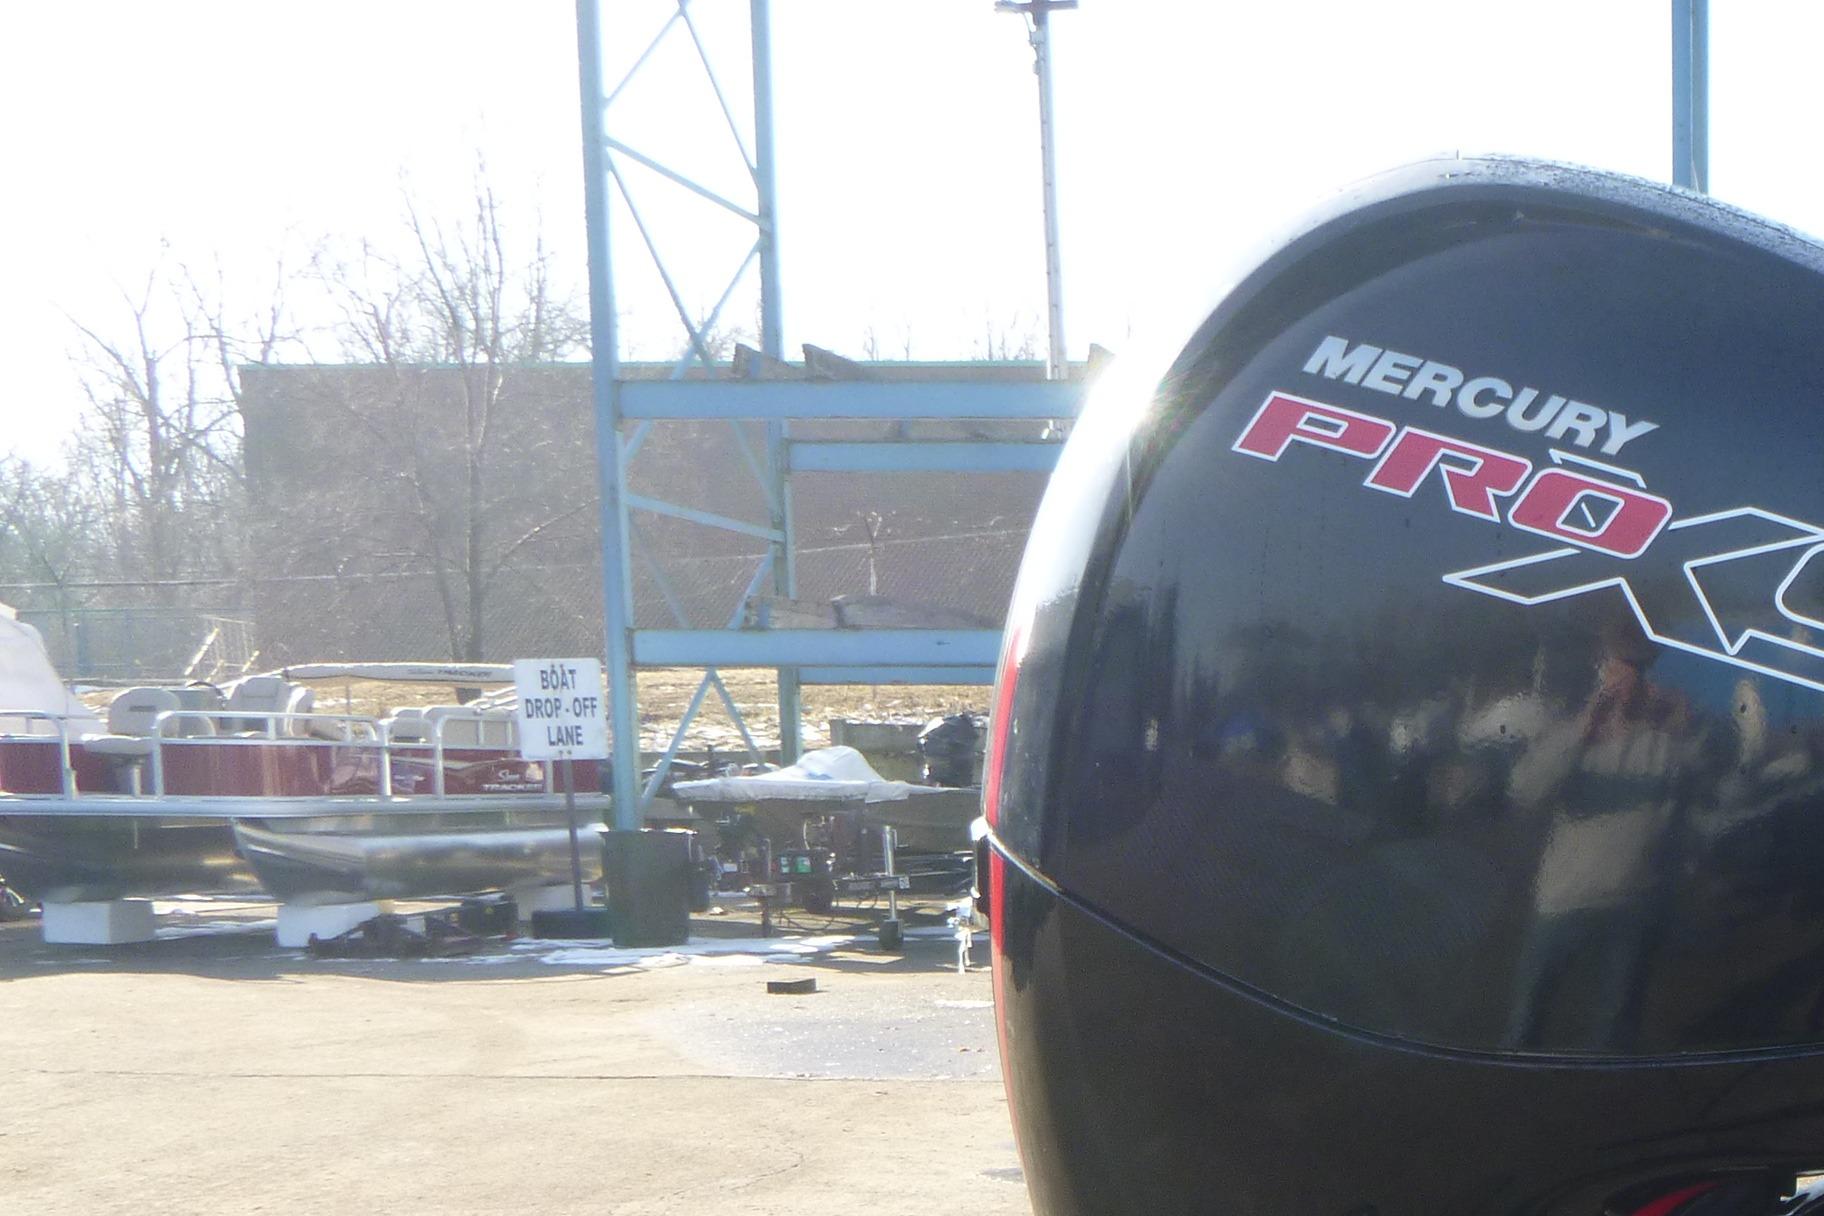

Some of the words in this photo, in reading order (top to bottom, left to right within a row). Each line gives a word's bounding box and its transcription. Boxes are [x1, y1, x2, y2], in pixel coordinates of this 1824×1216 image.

[1303, 335, 1659, 456] MERCURY
[1231, 390, 1673, 559] PRO
[540, 667, 577, 690] BOAT
[547, 726, 584, 747] LANE
